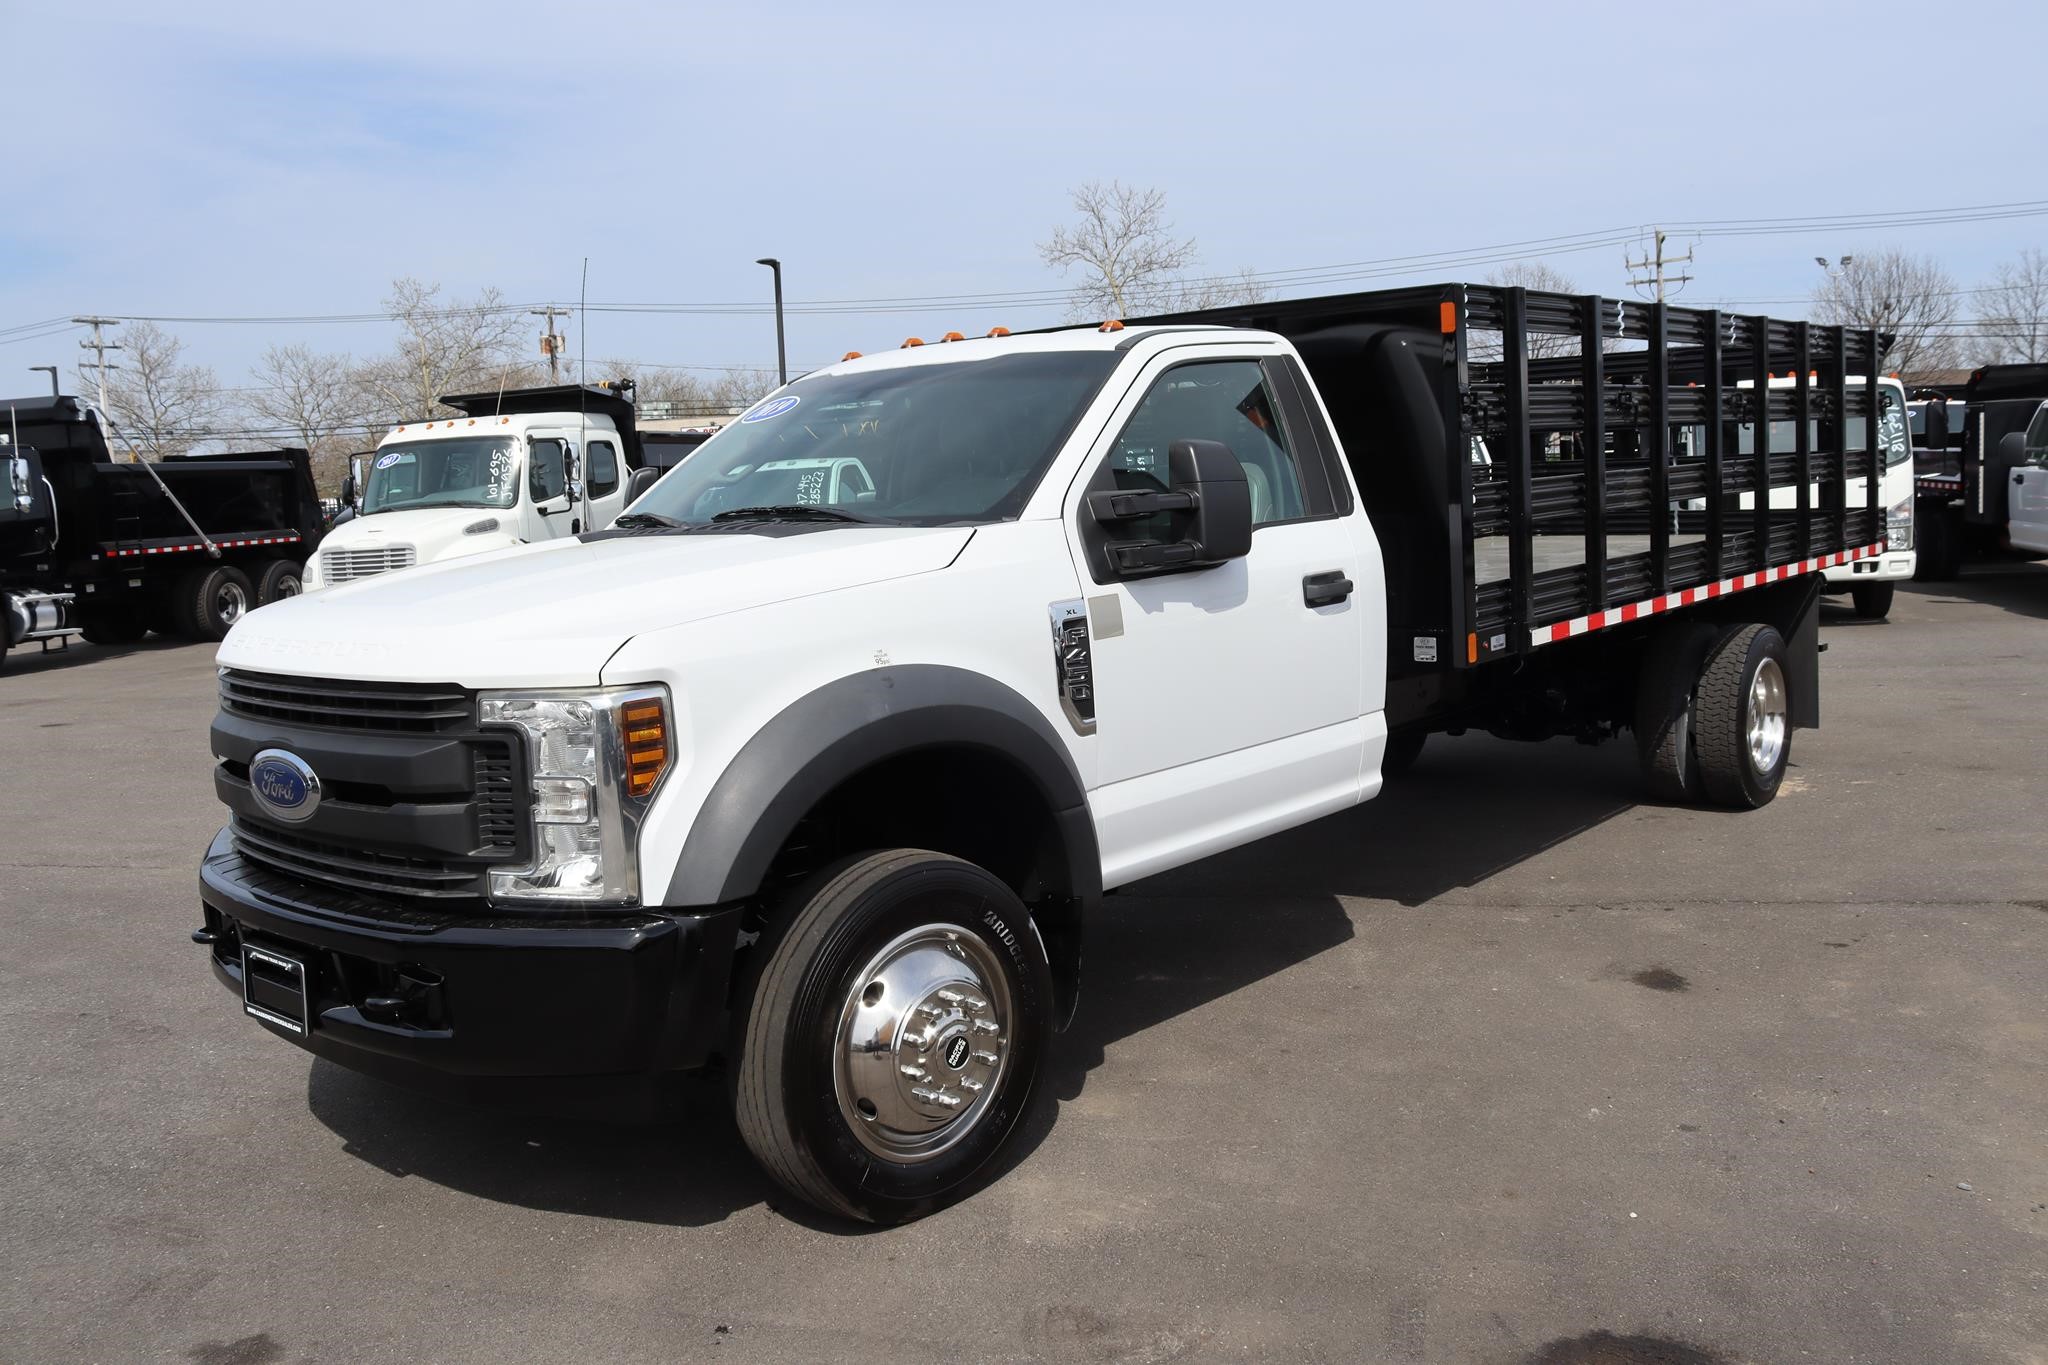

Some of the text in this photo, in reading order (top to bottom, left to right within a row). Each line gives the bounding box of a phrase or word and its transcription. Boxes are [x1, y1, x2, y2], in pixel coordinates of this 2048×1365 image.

[487, 449, 502, 499] 101-695
[1065, 608, 1078, 616] XL
[261, 766, 295, 800] Ford
